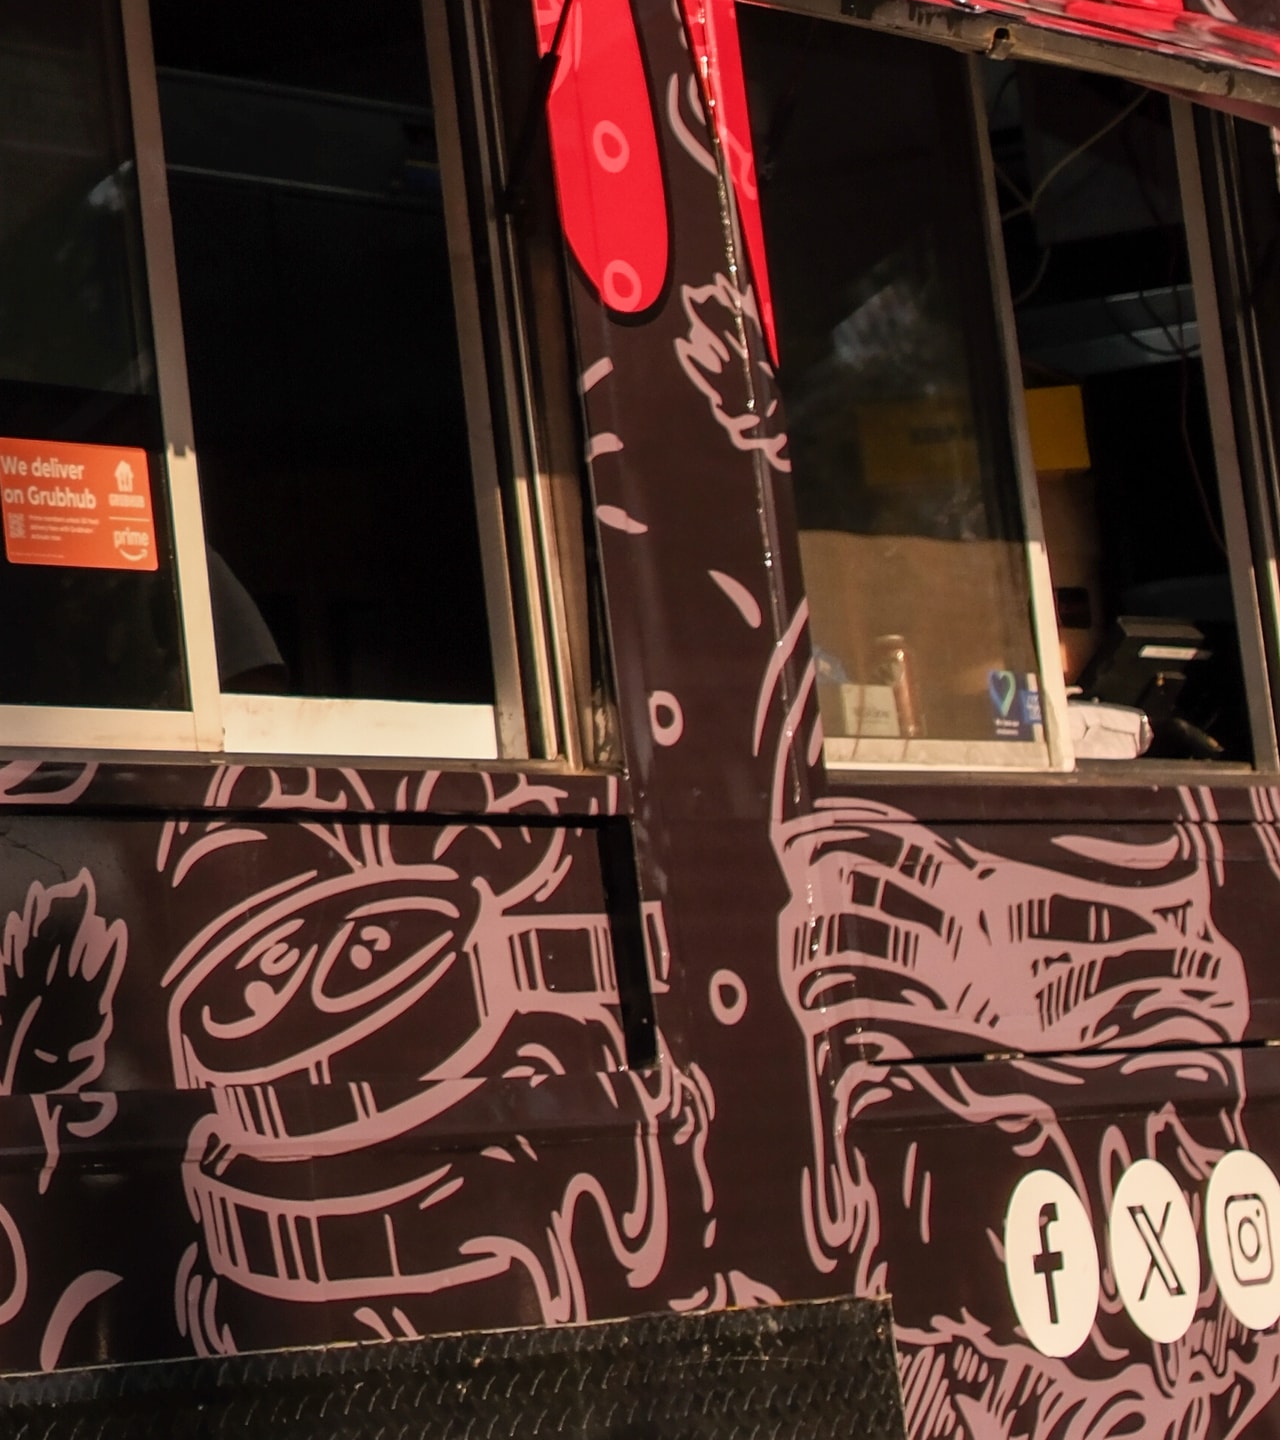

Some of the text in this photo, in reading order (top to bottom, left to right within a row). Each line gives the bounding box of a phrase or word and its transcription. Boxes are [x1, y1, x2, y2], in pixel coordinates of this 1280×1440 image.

[0, 456, 85, 481] We deliver
[3, 486, 97, 510] on Grubhub
[112, 526, 150, 549] prime
